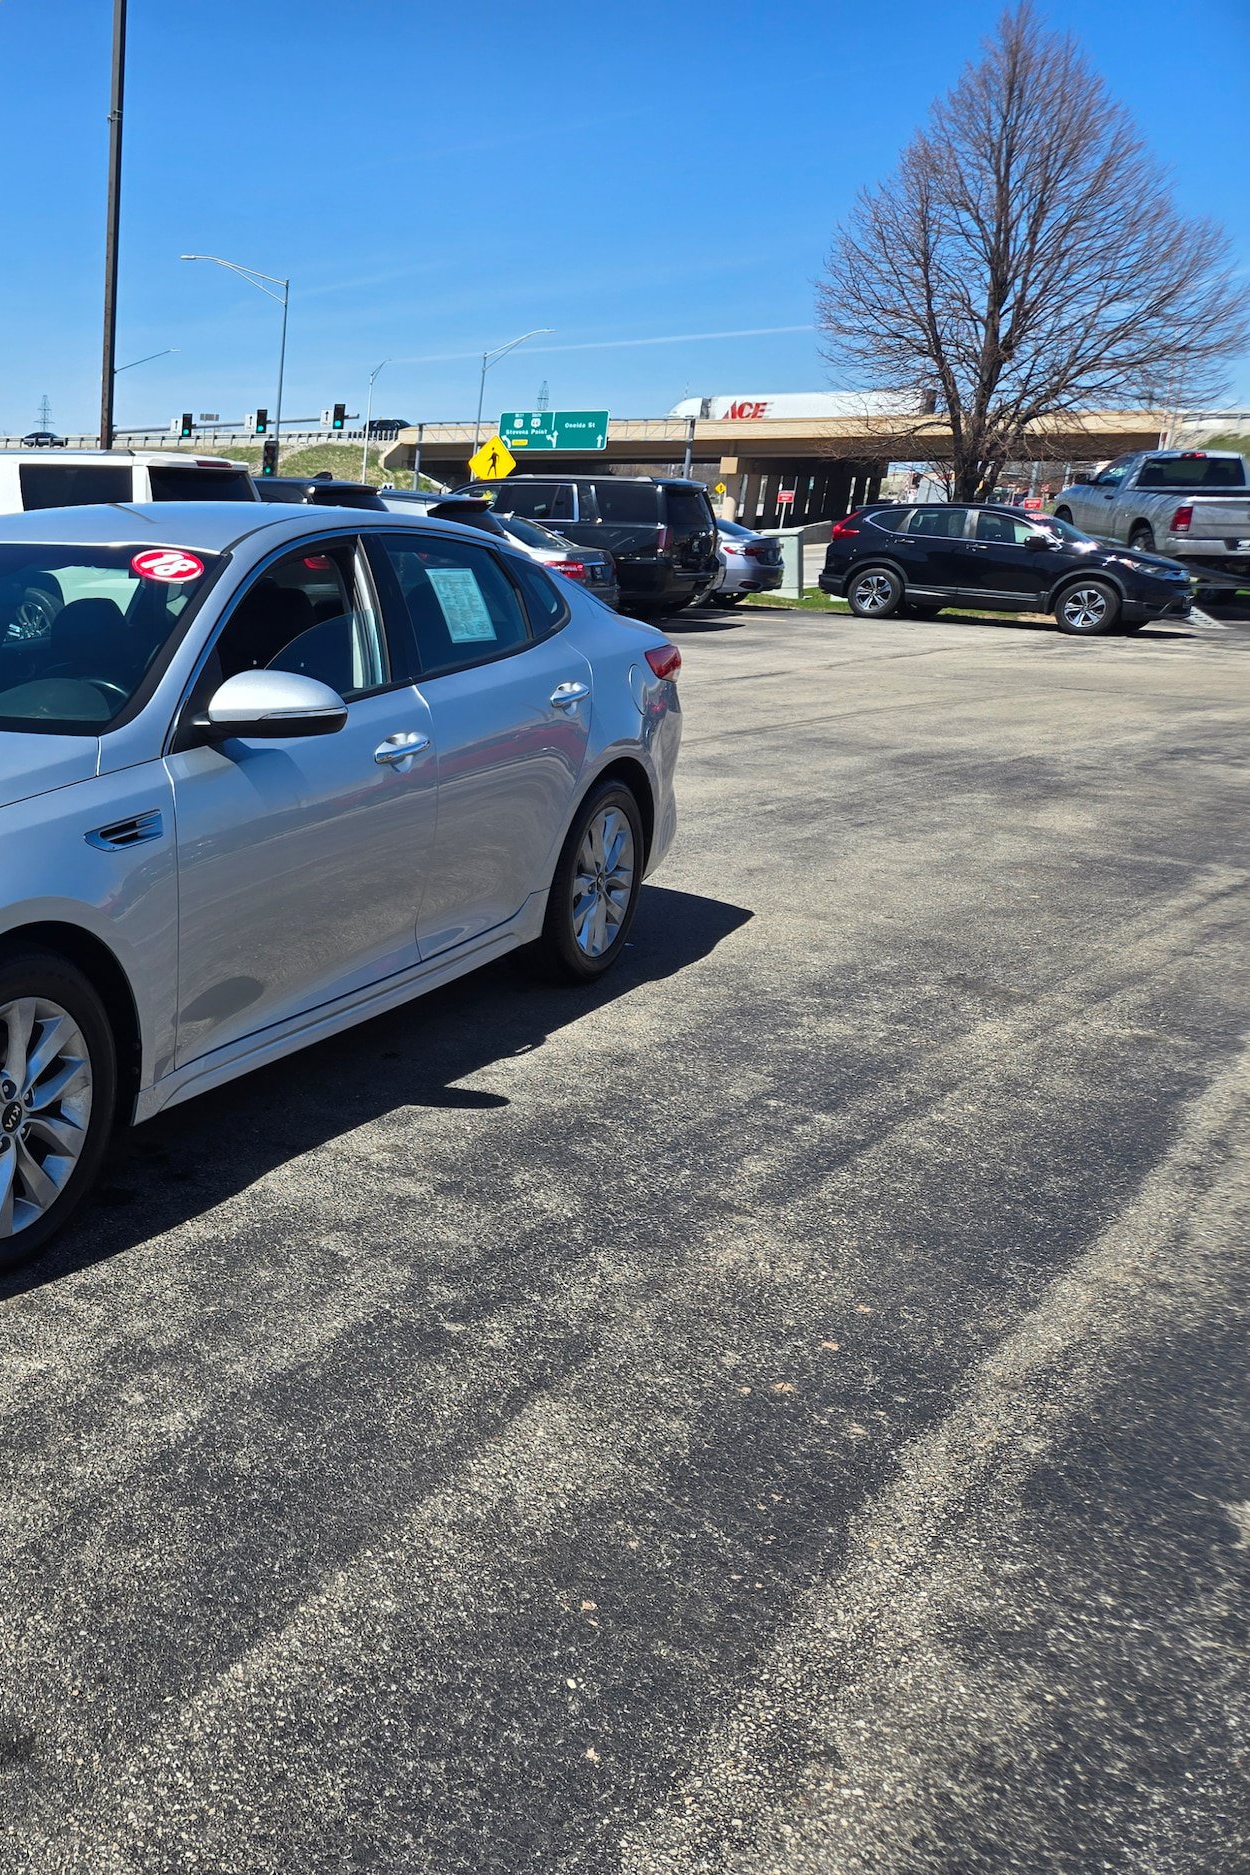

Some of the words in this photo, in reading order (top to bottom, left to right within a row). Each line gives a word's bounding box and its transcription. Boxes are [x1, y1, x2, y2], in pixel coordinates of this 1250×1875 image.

[722, 400, 769, 420] ACE
[588, 421, 596, 429] St
[140, 554, 198, 577] 18
[4, 1105, 21, 1129] KIA
